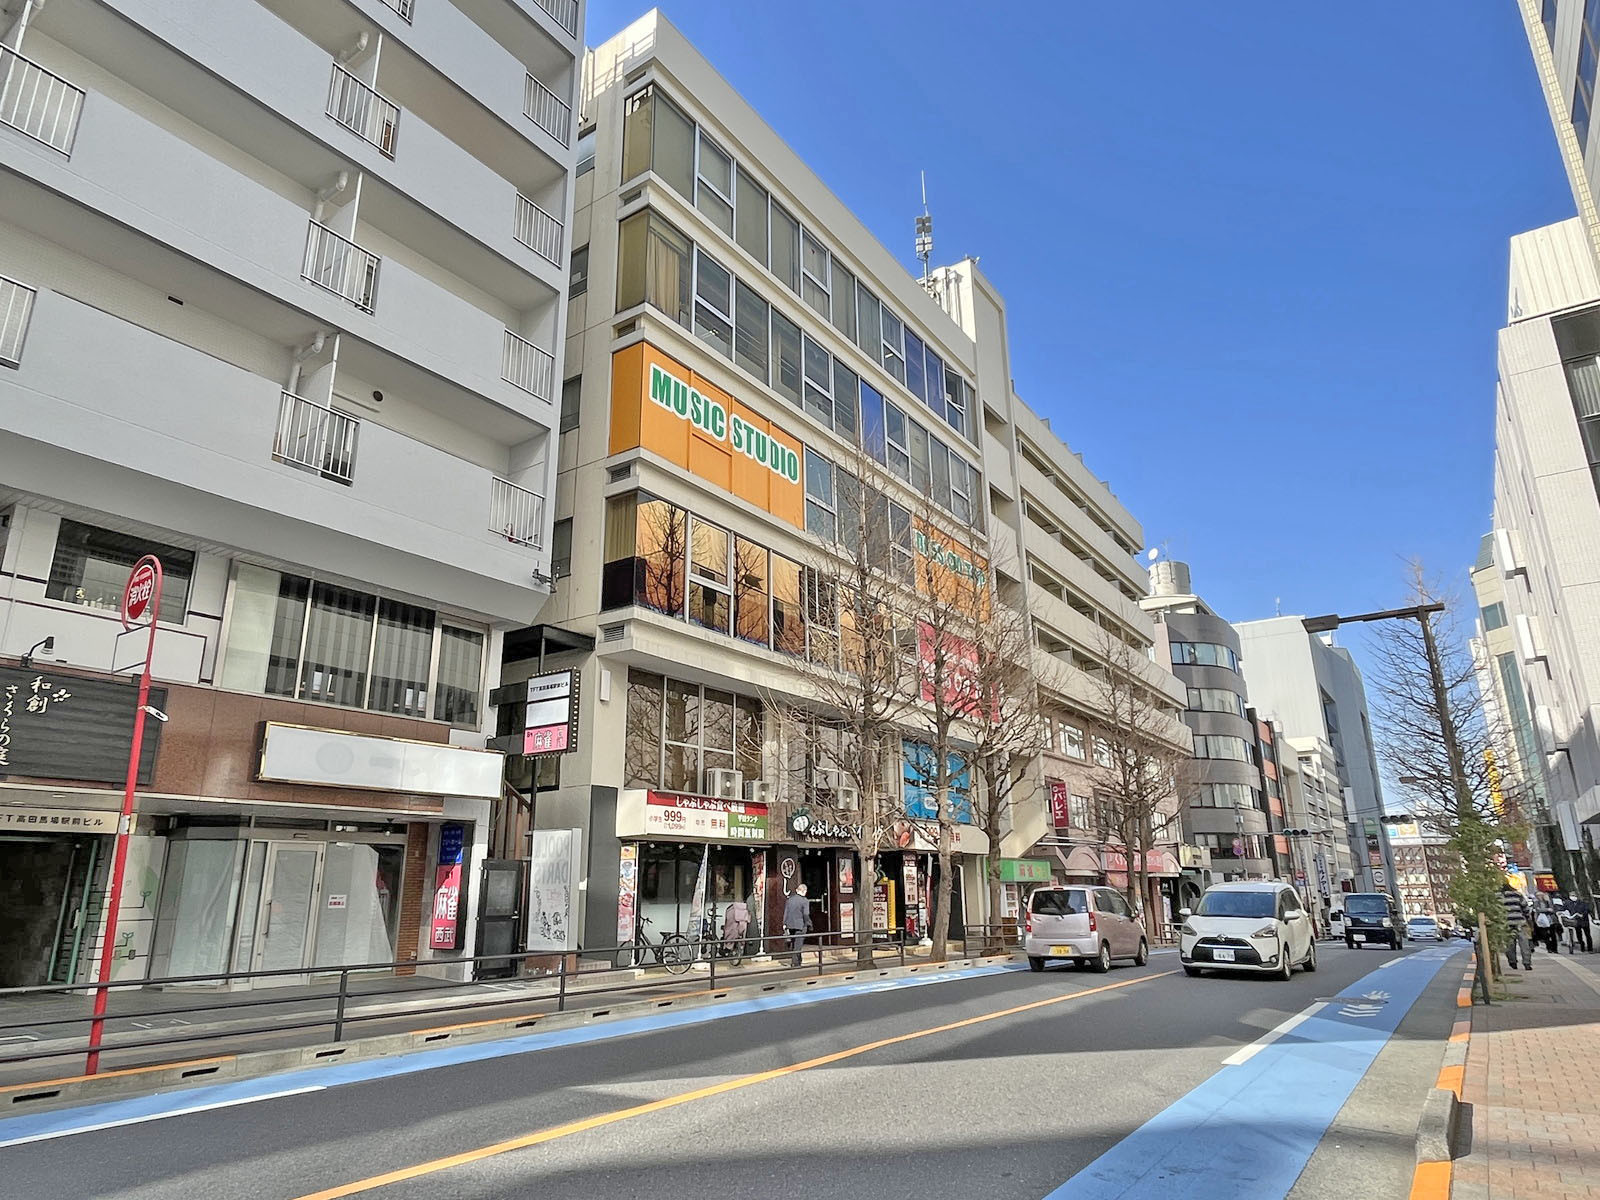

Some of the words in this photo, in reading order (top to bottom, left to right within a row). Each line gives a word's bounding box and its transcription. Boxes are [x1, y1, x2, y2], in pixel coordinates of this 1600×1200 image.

[650, 365, 726, 440] MUSIC
[730, 414, 799, 484] STUDIO
[129, 578, 152, 607] 消火栓
[435, 884, 459, 920] 麻雀
